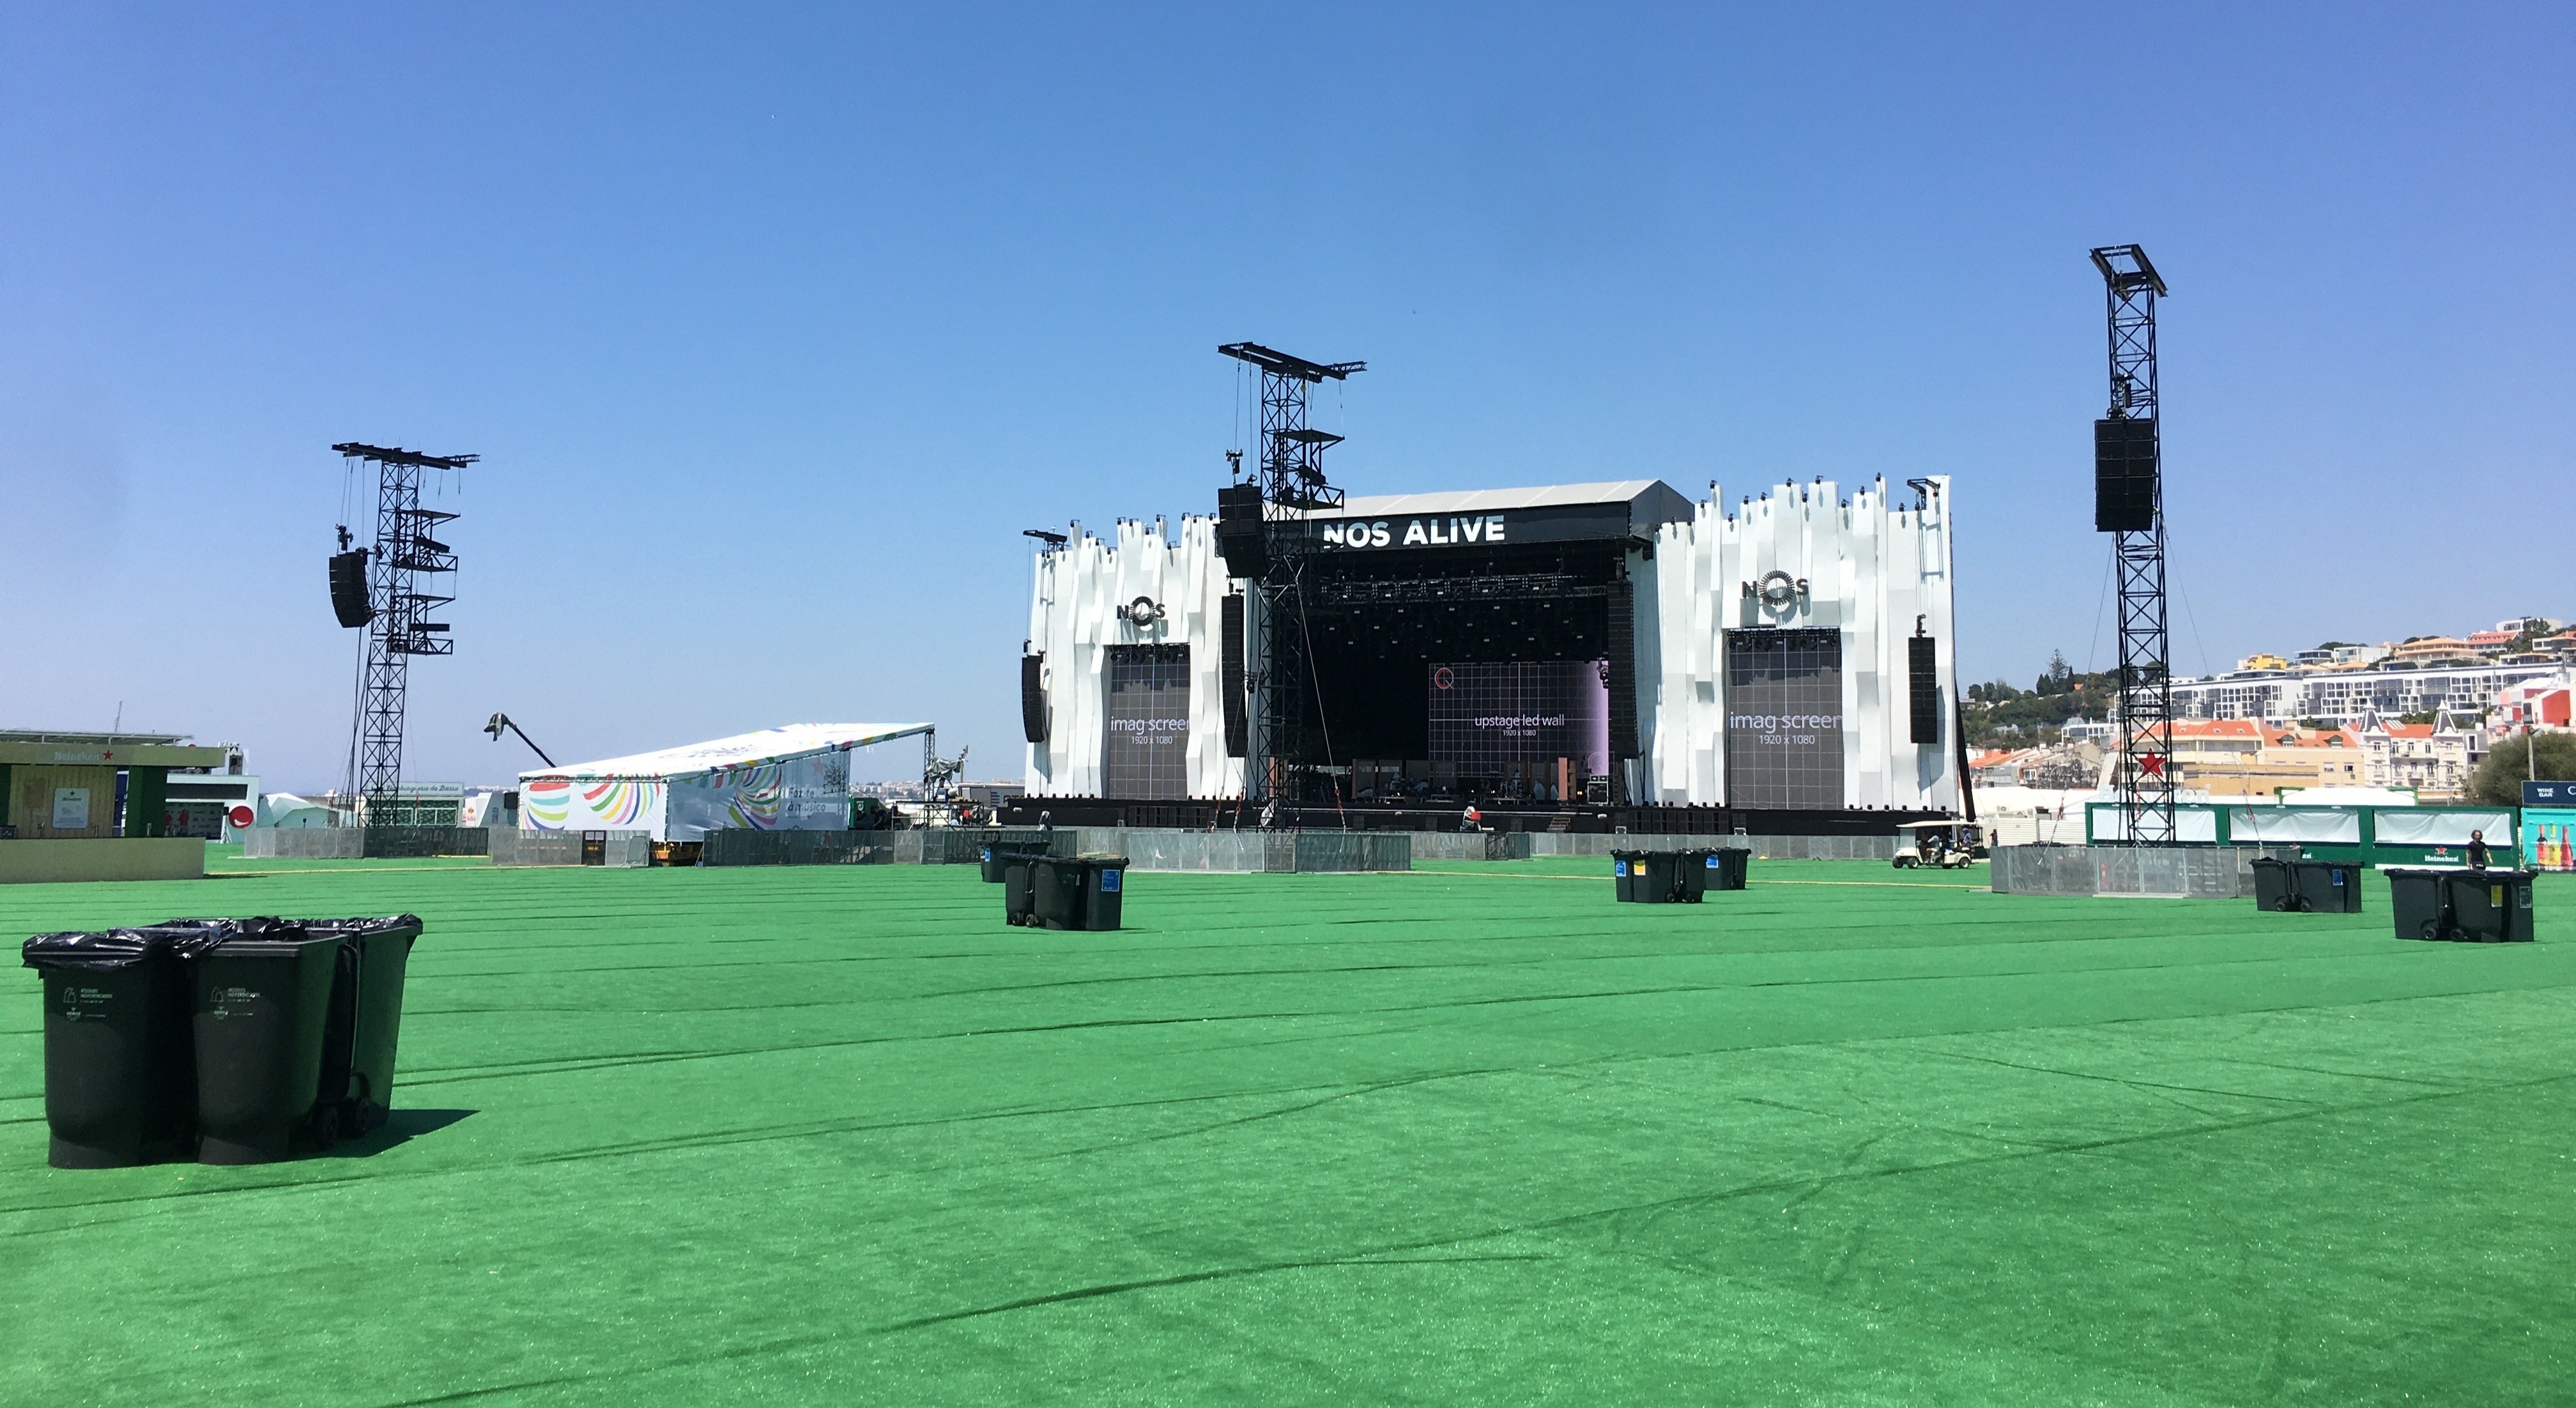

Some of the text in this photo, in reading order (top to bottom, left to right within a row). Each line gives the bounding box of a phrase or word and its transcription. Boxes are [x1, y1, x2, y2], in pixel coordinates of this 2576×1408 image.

[1324, 515, 1505, 549] NOS ALIVE
[1742, 570, 1808, 606] NOS
[1117, 596, 1165, 626] NOS
[1110, 716, 1145, 735] imag
[1475, 714, 1565, 729] upstage led wall
[1730, 711, 1776, 733] imag
[1131, 736, 1148, 744] 1920
[1156, 736, 1173, 744] 1080
[1759, 735, 1782, 744] 1920
[1792, 735, 1815, 744] 1080
[795, 800, 825, 812] música
